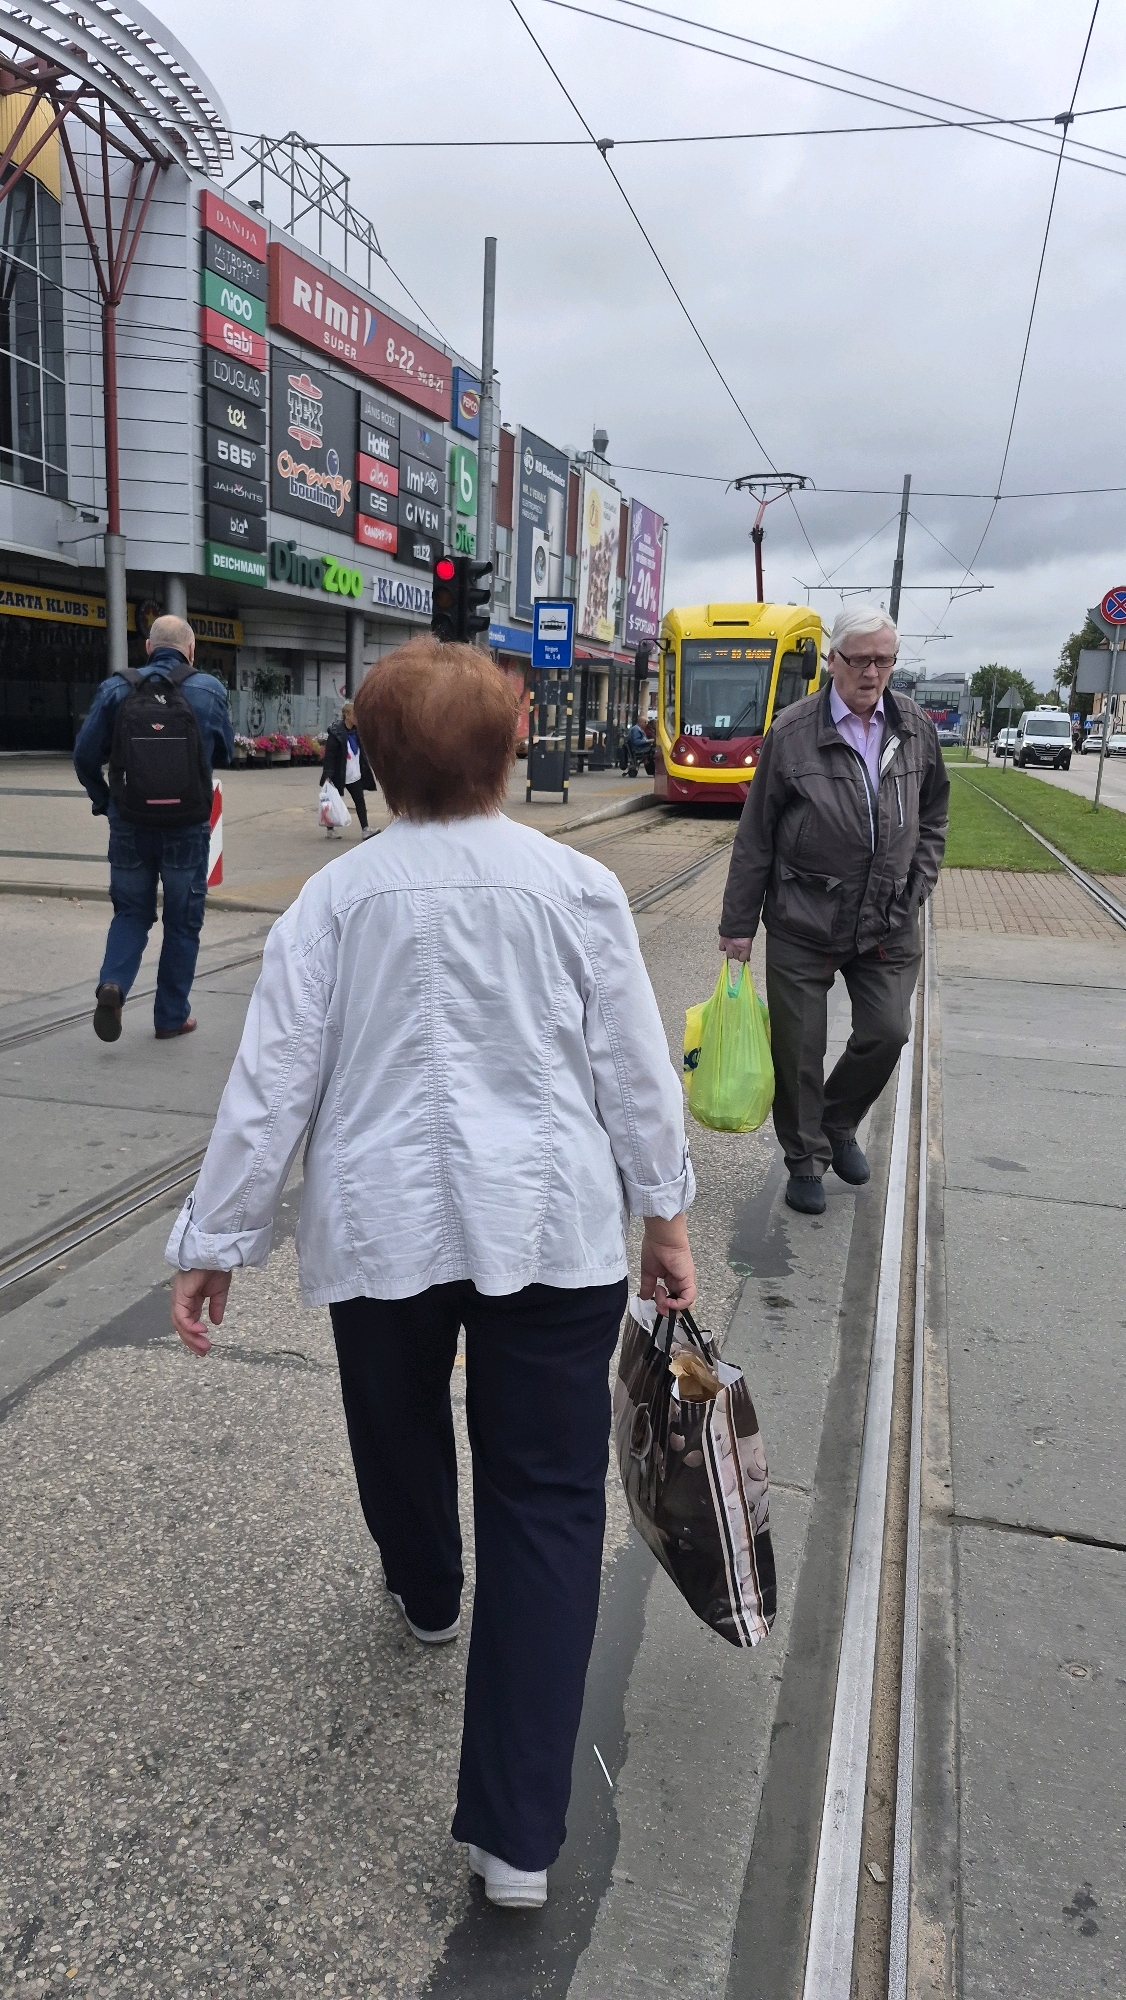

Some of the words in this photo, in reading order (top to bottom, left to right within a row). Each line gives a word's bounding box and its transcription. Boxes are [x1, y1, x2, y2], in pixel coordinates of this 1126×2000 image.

[216, 209, 257, 245] DANIJA
[214, 243, 260, 280] METROPOLE
[215, 257, 250, 284] OUTLET
[292, 276, 360, 342] Rimi
[223, 322, 252, 355] Gabi
[323, 331, 357, 360] SUPER
[386, 338, 415, 376] 8-22
[213, 359, 260, 398] DOUGLAS
[227, 405, 247, 430] tet
[287, 389, 323, 436] TEX
[462, 395, 478, 413] PEPCO
[213, 481, 263, 503] JAHONTS
[277, 450, 352, 517] Orange
[289, 474, 338, 513] bowling
[405, 502, 439, 530] GIVEN
[213, 553, 266, 577] DEICHMANN
[271, 540, 364, 598] DinoZoo
[413, 545, 431, 562] TELE2
[46, 598, 89, 617] KLUBS
[377, 577, 432, 614] KLONDA
[189, 618, 235, 639] NDAIKA
[684, 724, 703, 736] 015
